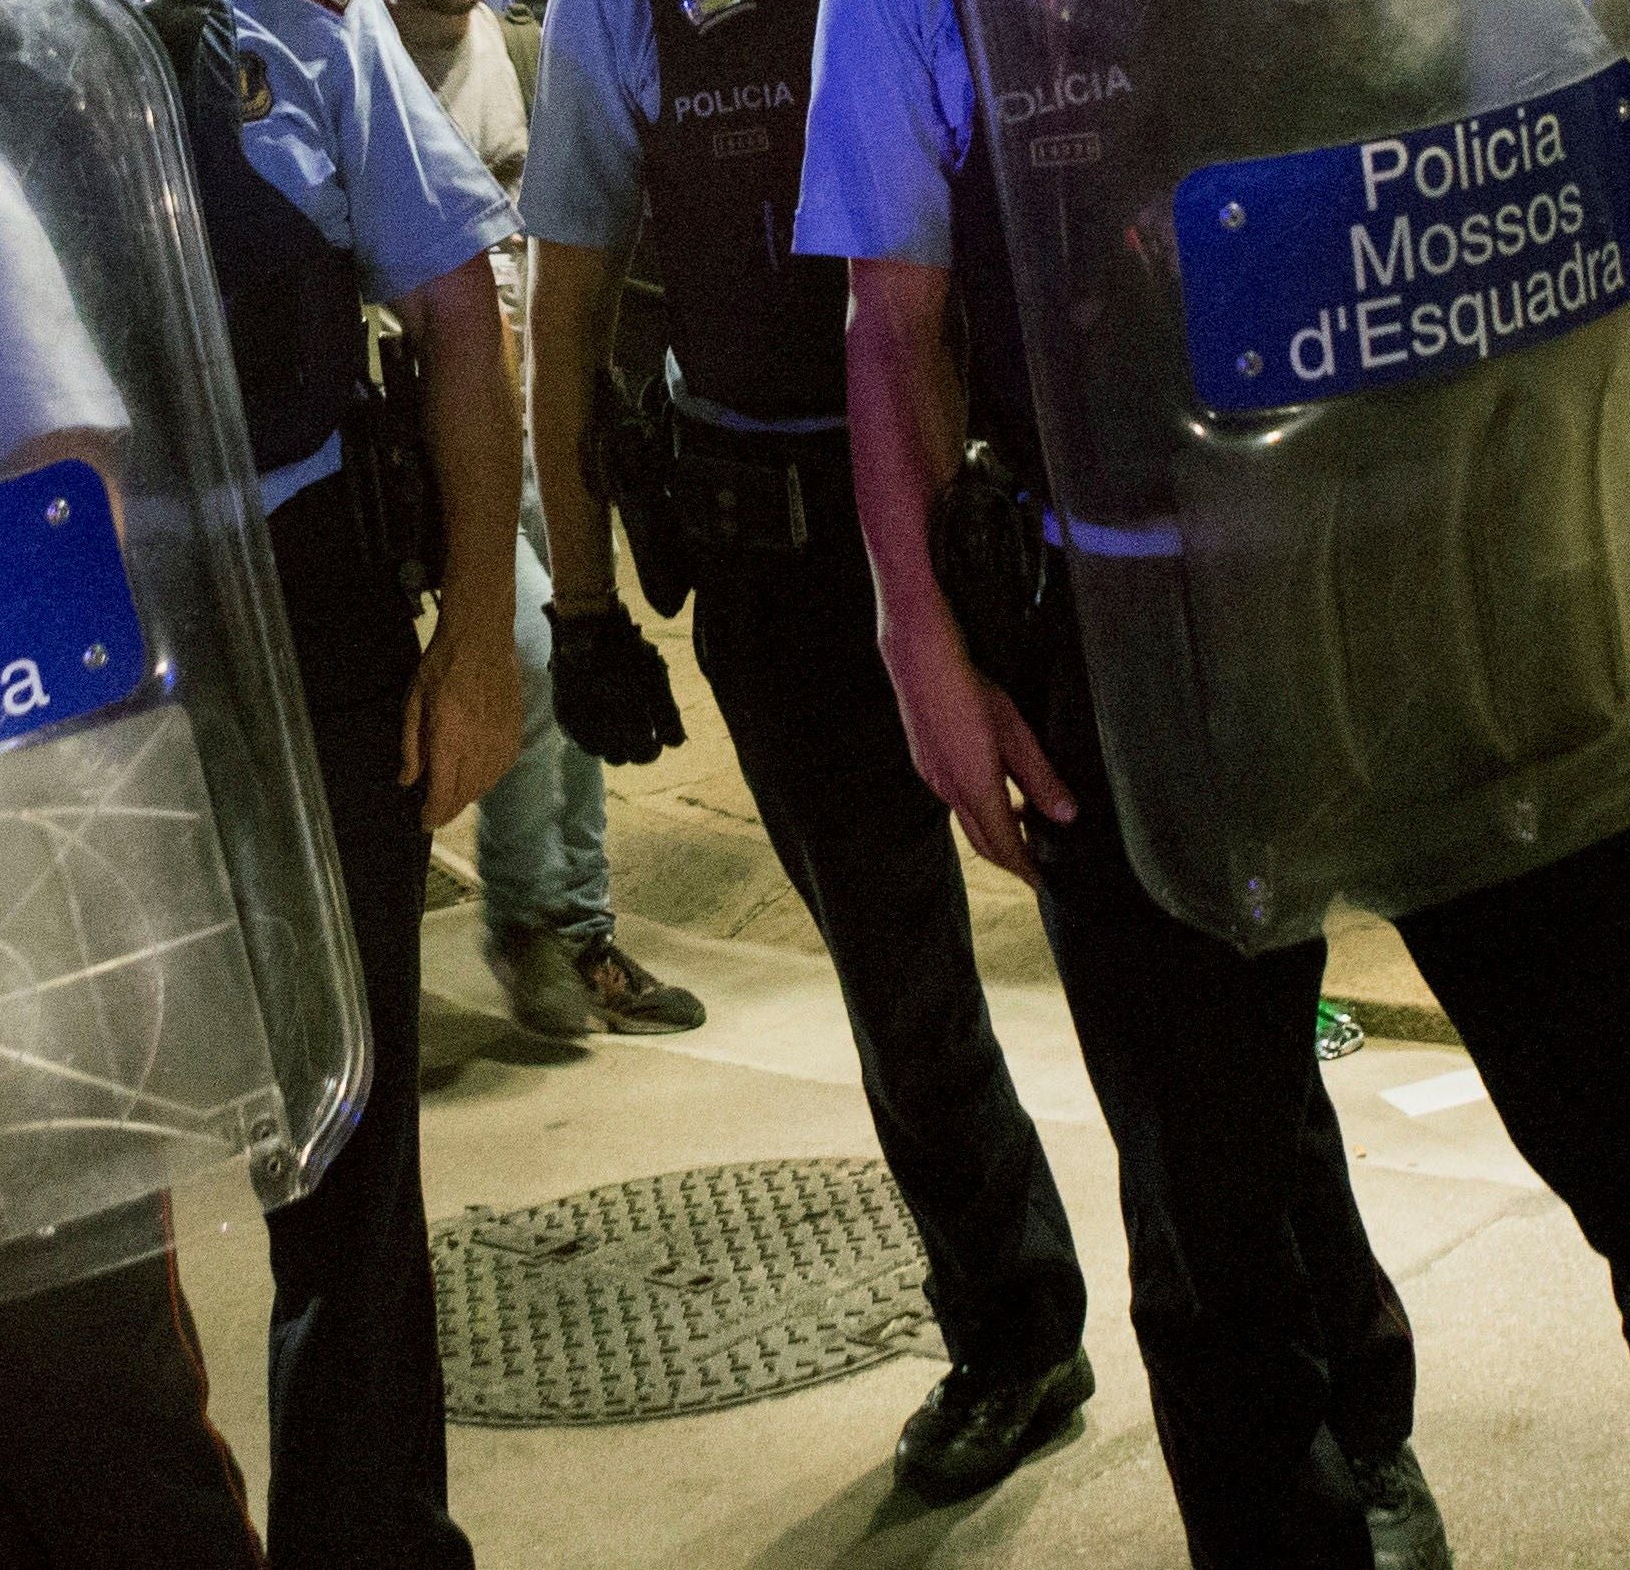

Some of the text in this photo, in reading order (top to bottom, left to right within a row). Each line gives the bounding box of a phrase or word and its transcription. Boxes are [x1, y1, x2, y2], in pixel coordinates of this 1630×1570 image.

[673, 80, 796, 124] POLICIA
[1361, 108, 1566, 211] Policia
[1350, 183, 1584, 292] Mossos
[1289, 241, 1625, 380] d'Esquadra
